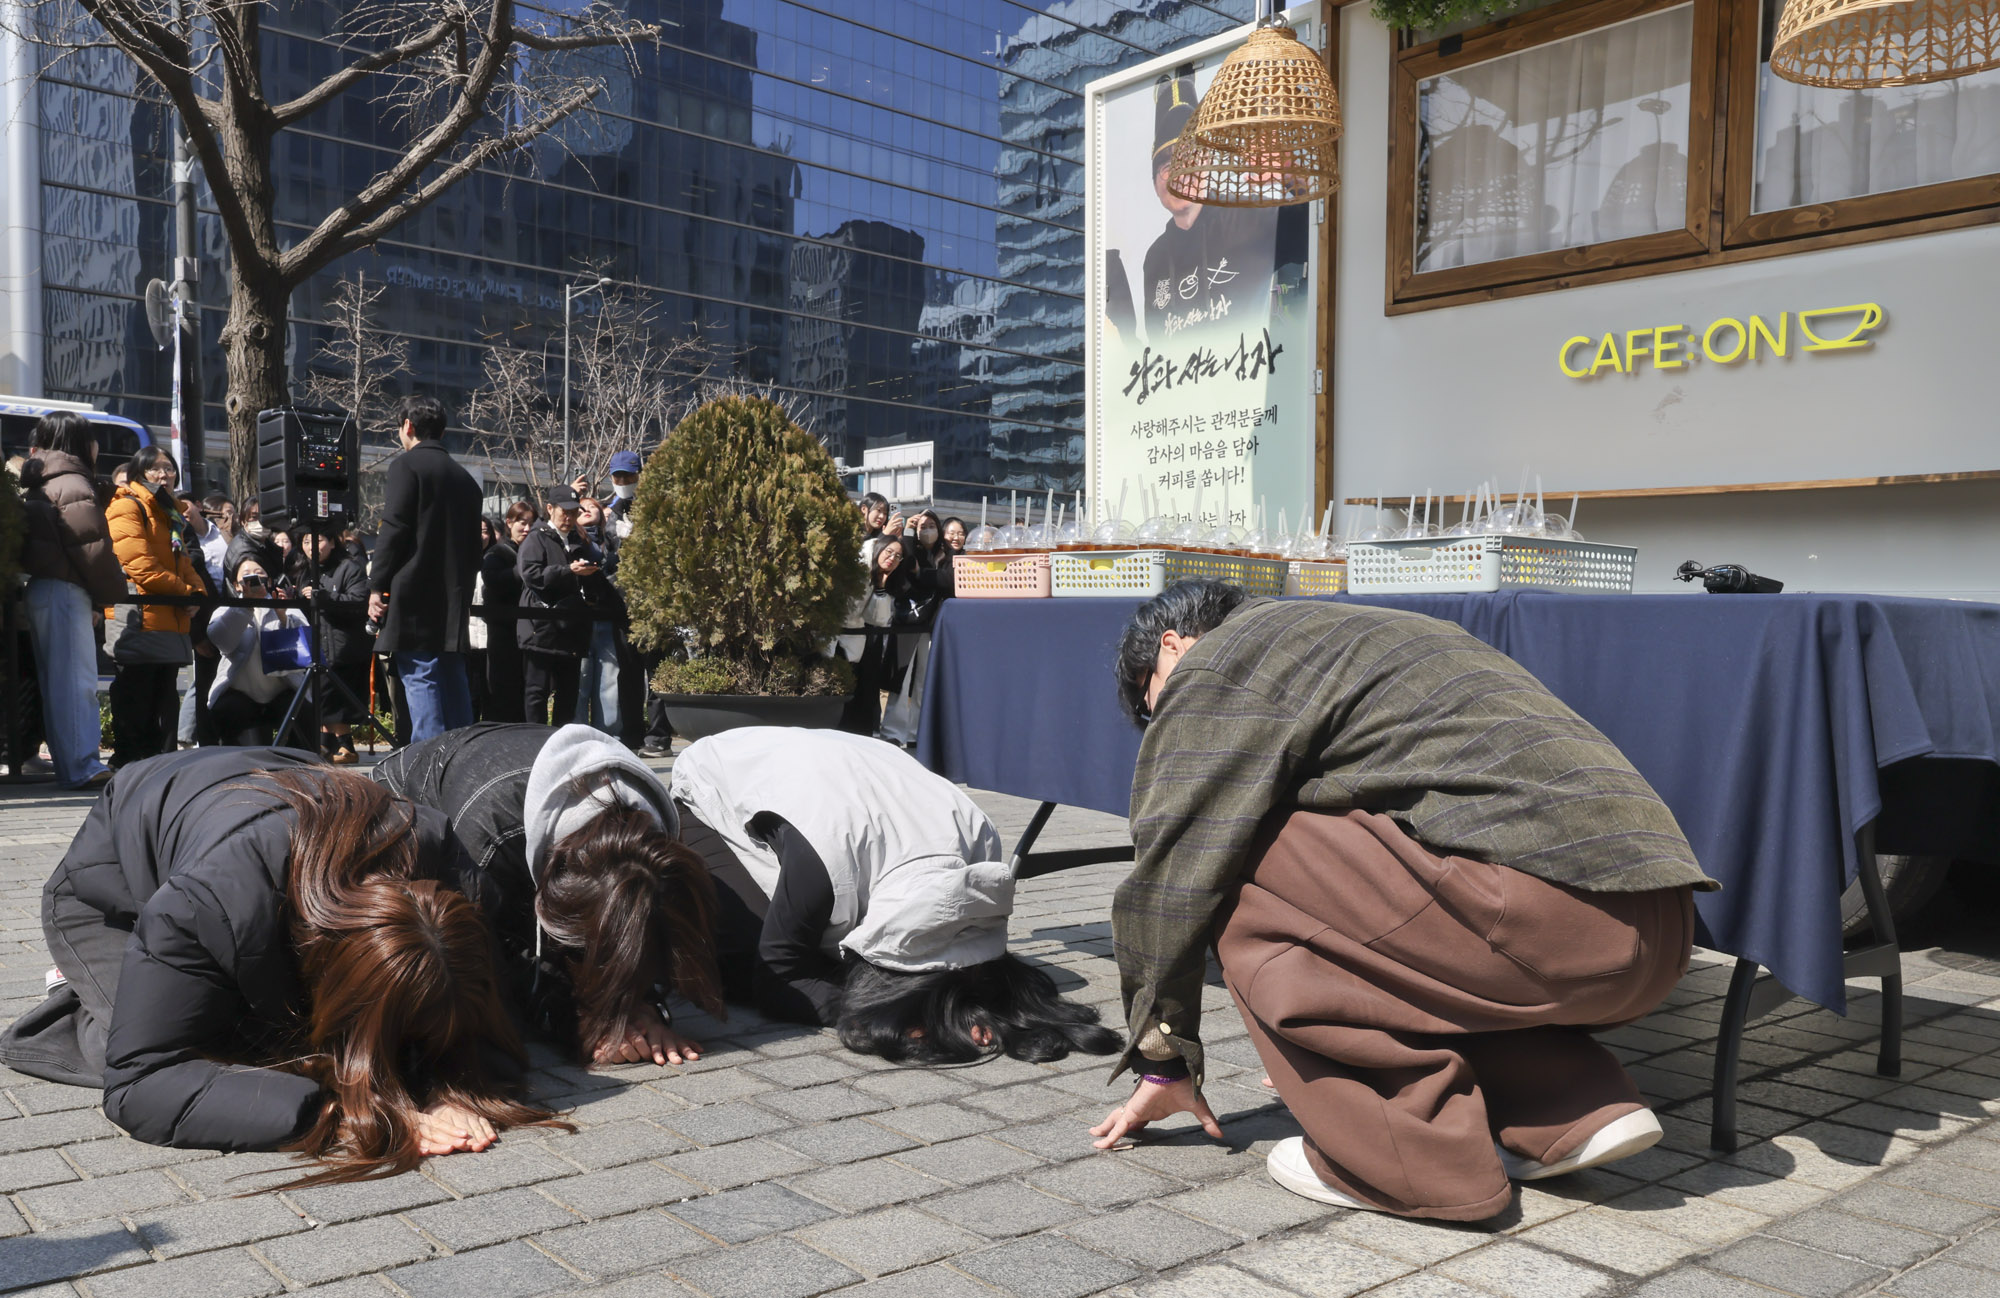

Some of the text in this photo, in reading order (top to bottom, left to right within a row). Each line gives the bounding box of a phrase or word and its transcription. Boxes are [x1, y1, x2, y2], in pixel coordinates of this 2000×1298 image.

[1558, 310, 1791, 378] CAFE:ON
[1122, 327, 1284, 405] 왕과 사는 남자
[1130, 404, 1278, 440] 사랑해주시는 관객분들께
[1147, 435, 1260, 465] 감사의 마음을 담아
[1158, 465, 1245, 491] 커피를 쏩니다!
